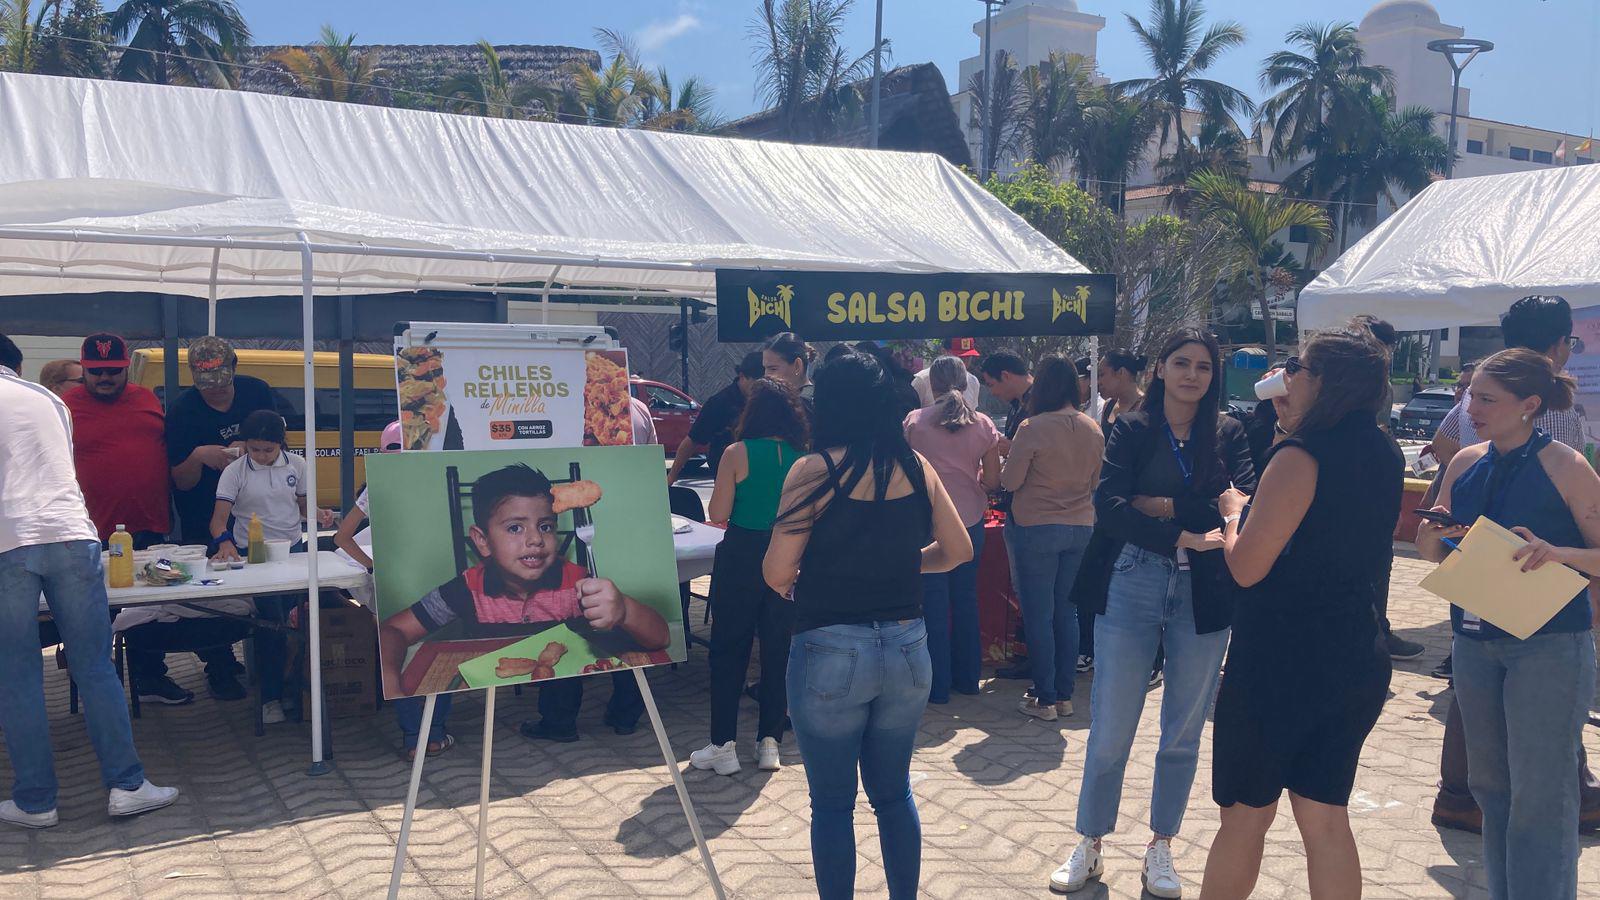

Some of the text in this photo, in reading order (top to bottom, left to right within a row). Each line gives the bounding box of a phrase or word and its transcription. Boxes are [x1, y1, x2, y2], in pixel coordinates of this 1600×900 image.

[747, 285, 795, 329] BICHI
[827, 290, 1025, 324] SALSA BICHI
[1052, 286, 1090, 324] BICHI
[478, 365, 552, 381] CHILES
[464, 382, 569, 398] RELLENOS
[480, 391, 545, 416] de Minilla
[491, 424, 511, 433] $35
